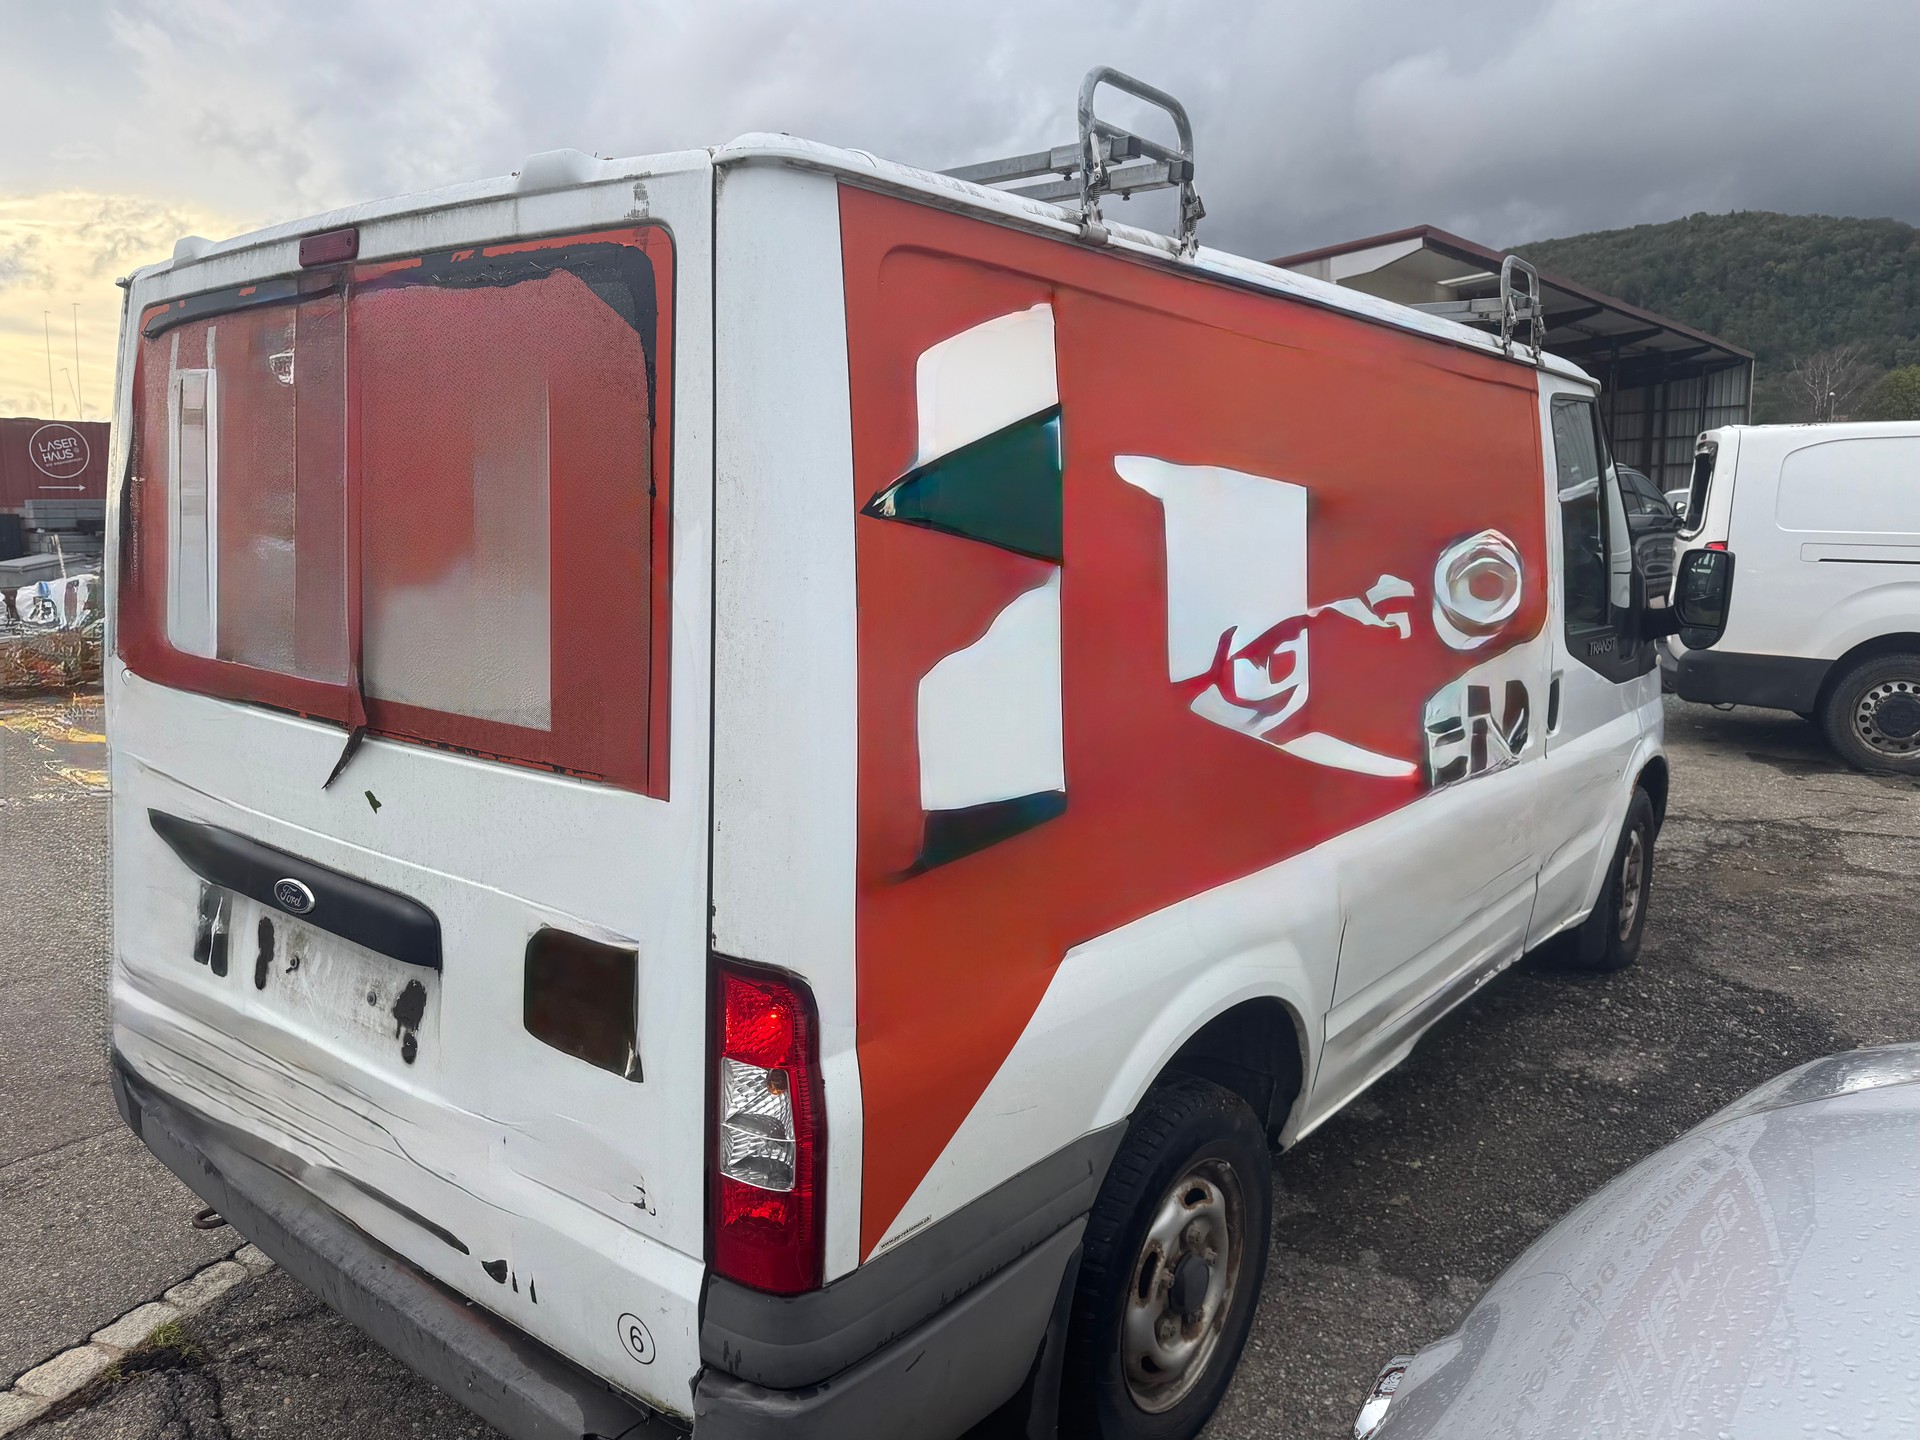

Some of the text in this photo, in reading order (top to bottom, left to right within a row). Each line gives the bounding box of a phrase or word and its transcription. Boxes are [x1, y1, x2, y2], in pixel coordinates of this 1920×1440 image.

[38, 437, 78, 453] LASER
[42, 448, 75, 463] HAUS
[1588, 636, 1616, 657] TRANSIT
[280, 885, 302, 907] Ford
[629, 1325, 645, 1354] 6
